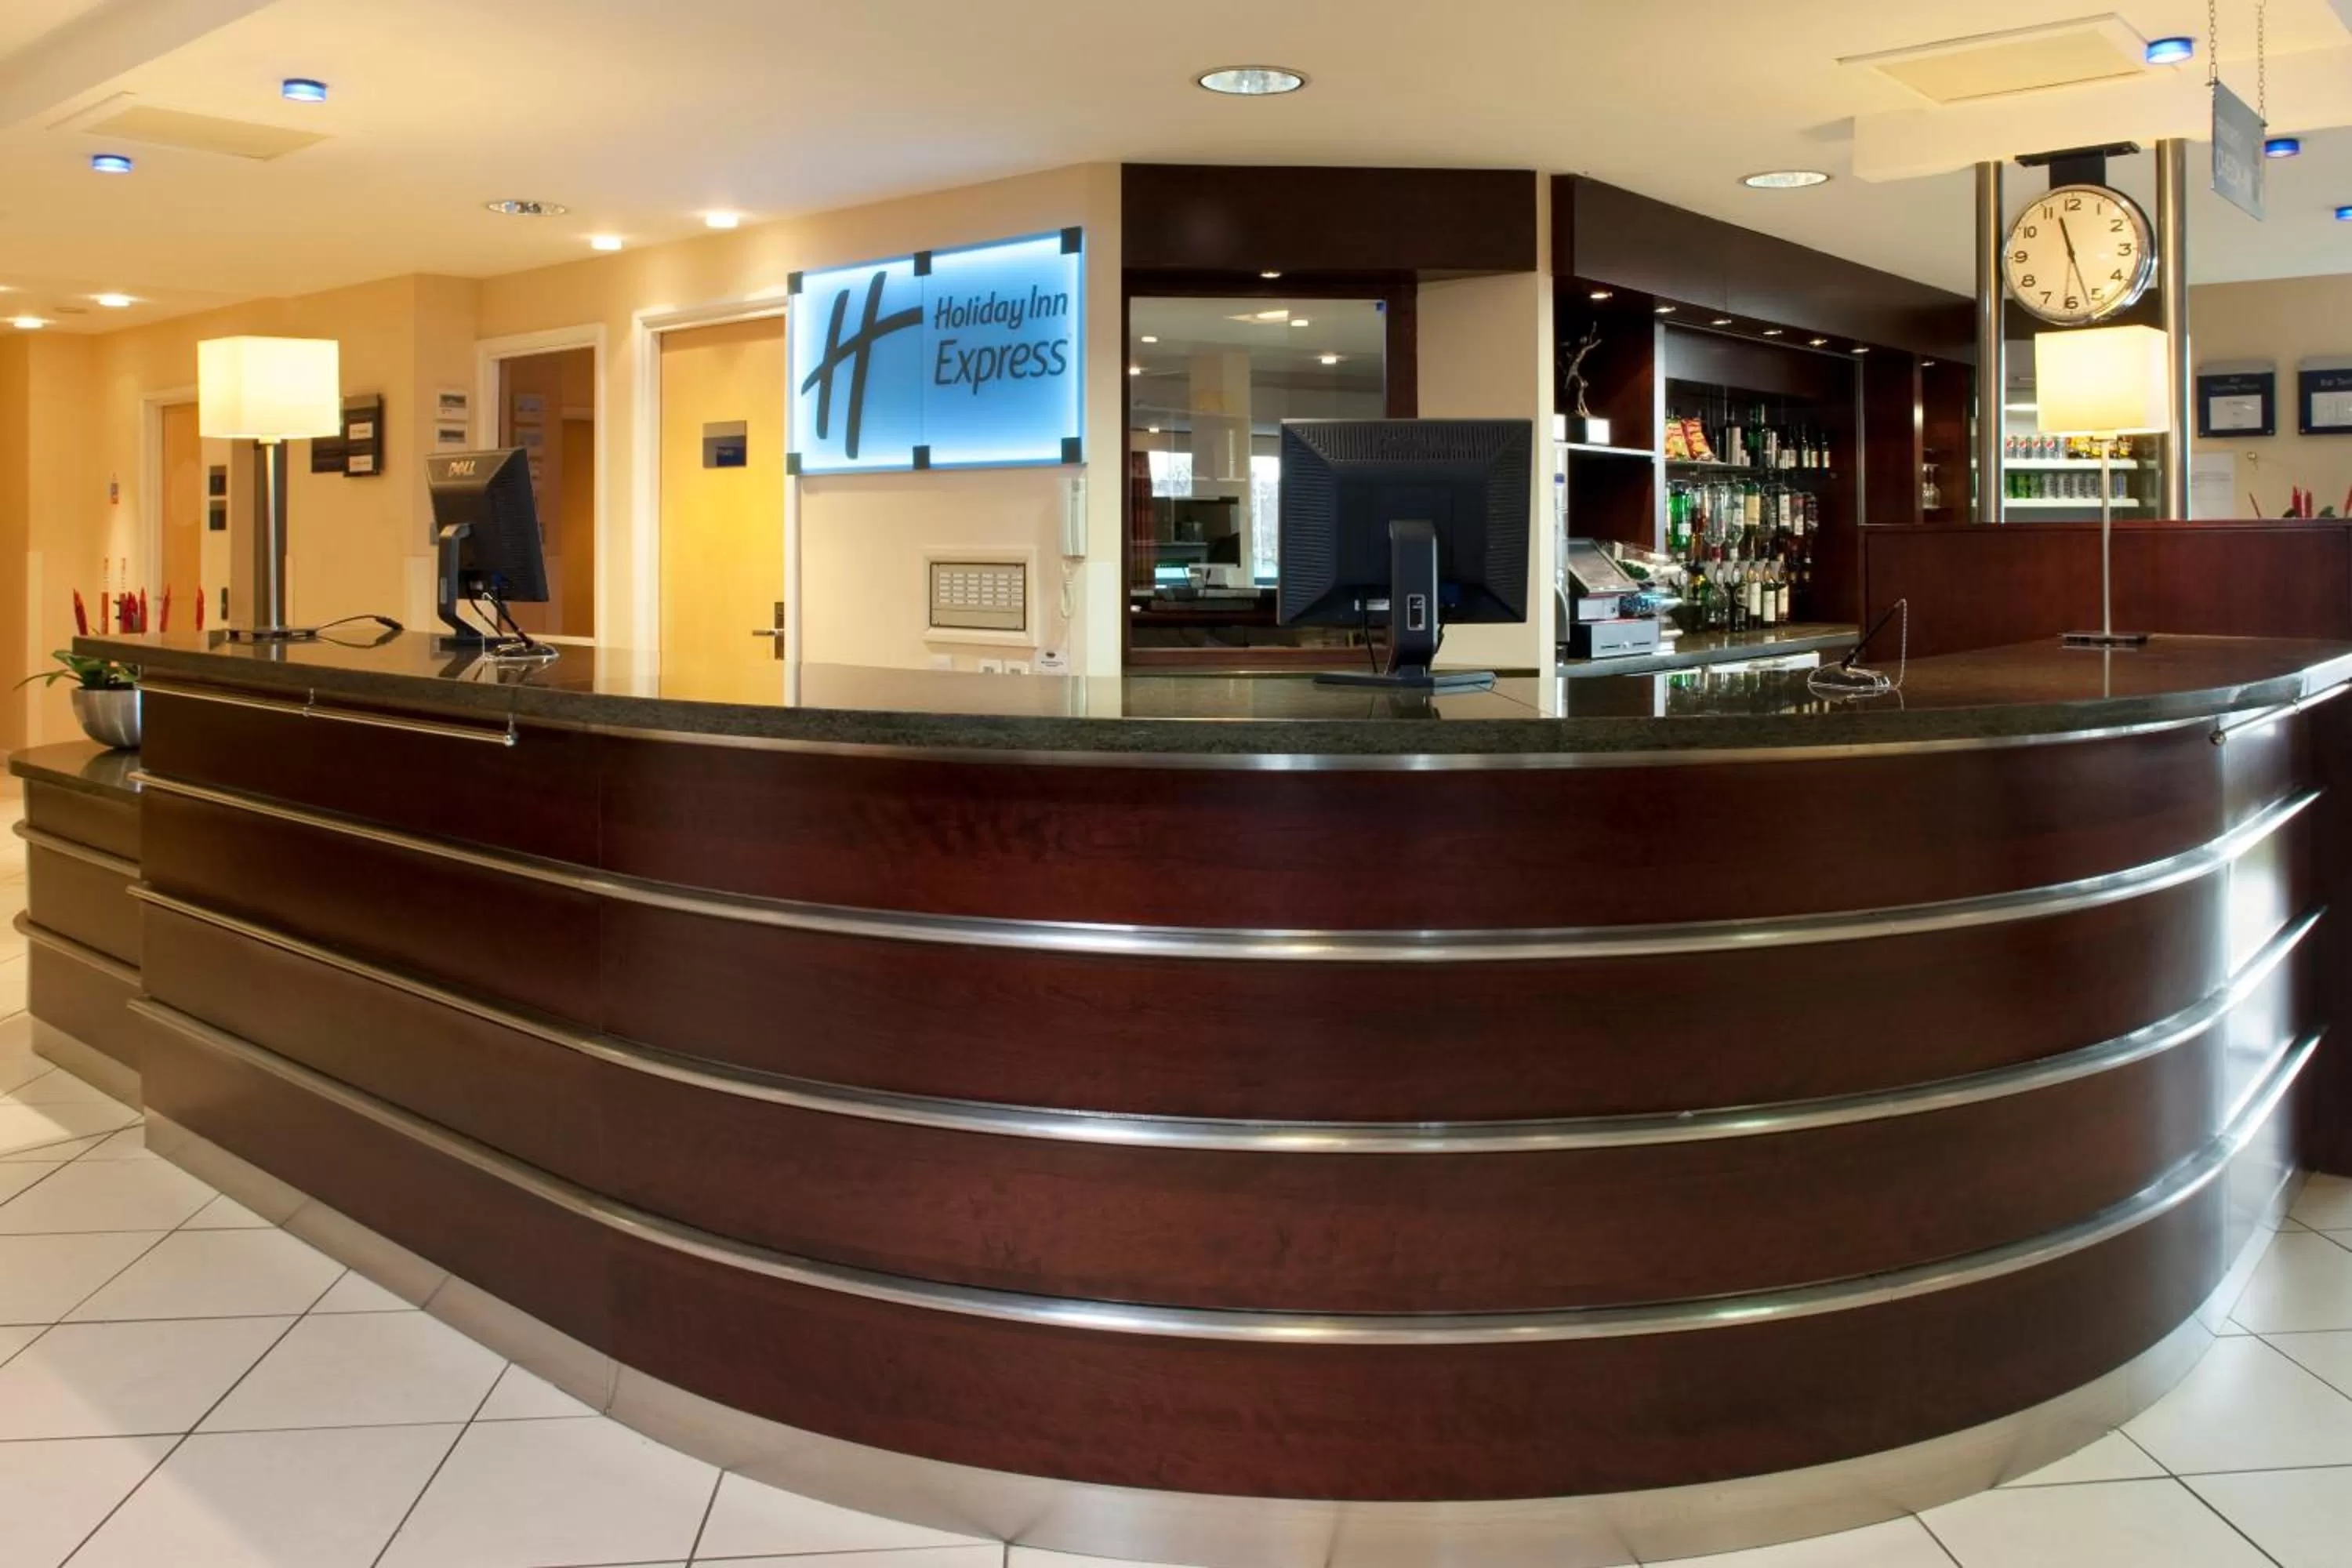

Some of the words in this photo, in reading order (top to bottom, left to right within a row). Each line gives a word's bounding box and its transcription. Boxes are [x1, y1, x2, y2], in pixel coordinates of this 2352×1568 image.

[2063, 198, 2082, 212] 12
[2096, 202, 2101, 215] 1
[2043, 206, 2053, 220] 11
[2023, 225, 2038, 239] 10
[2110, 219, 2124, 233] 2
[2118, 243, 2132, 256] 3
[2014, 250, 2028, 264] 9
[2021, 274, 2036, 288] 8
[2110, 269, 2124, 281] 4
[2041, 291, 2052, 304] 7
[2091, 288, 2104, 301] 5
[934, 290, 1026, 330] Holiday
[1029, 284, 1069, 318] Inn
[2063, 296, 2078, 310] 6
[933, 338, 1069, 395] Express
